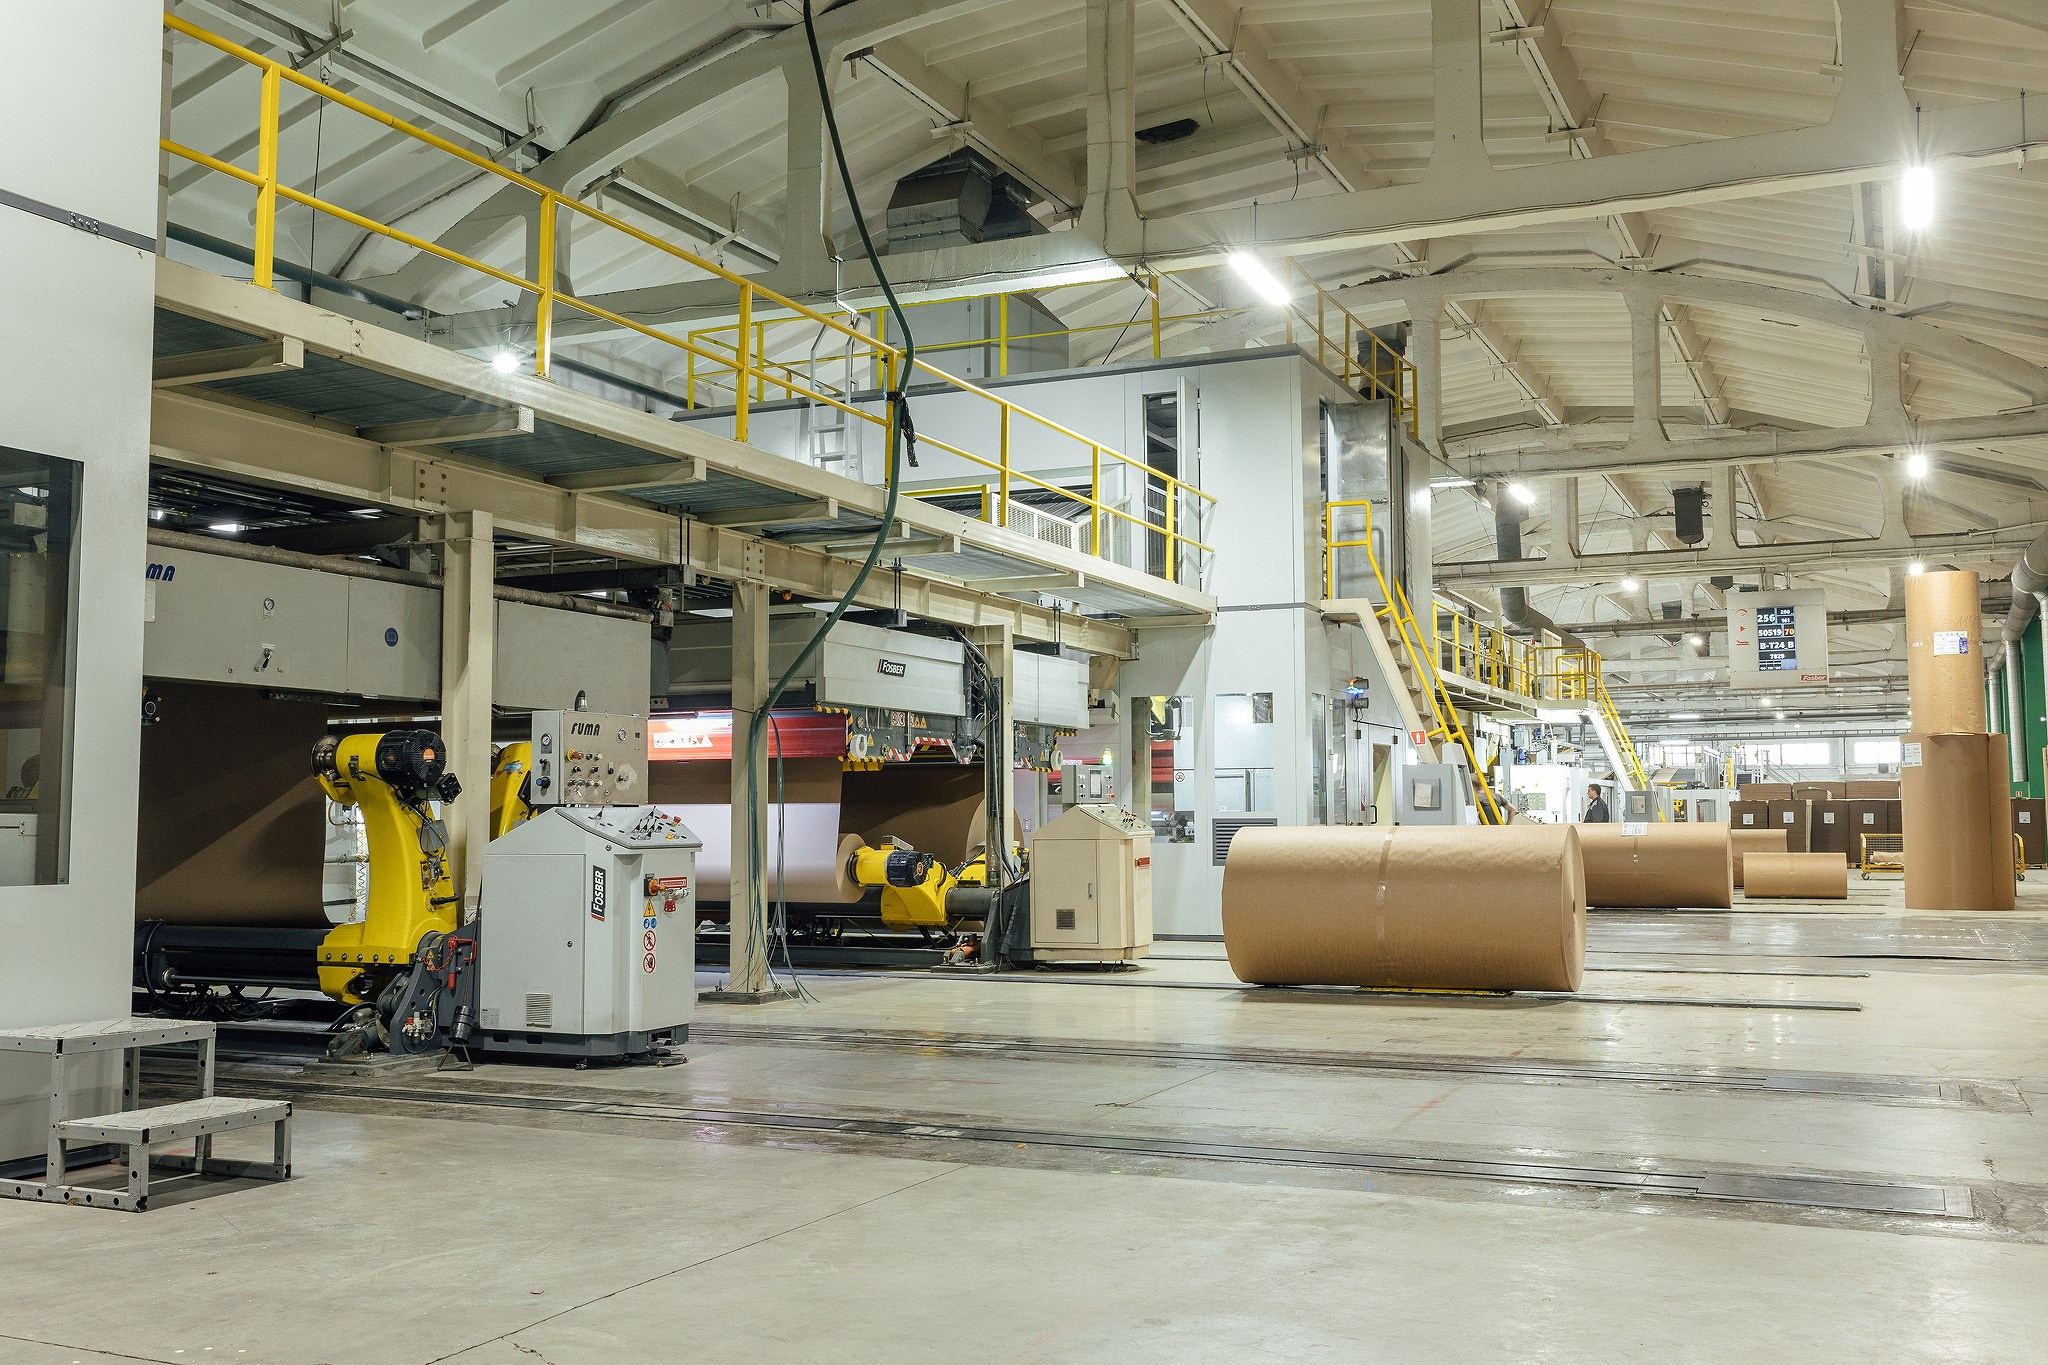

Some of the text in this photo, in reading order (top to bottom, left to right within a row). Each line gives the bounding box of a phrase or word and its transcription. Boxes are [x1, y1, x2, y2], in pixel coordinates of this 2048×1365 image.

[146, 563, 176, 582] MA
[1757, 614, 1775, 623] 256
[1758, 629, 1782, 637] 50519
[1760, 641, 1794, 649] B-T24_B
[882, 661, 904, 675] FOSBER
[571, 722, 600, 736] FUMA
[592, 869, 605, 913] FOSBER
